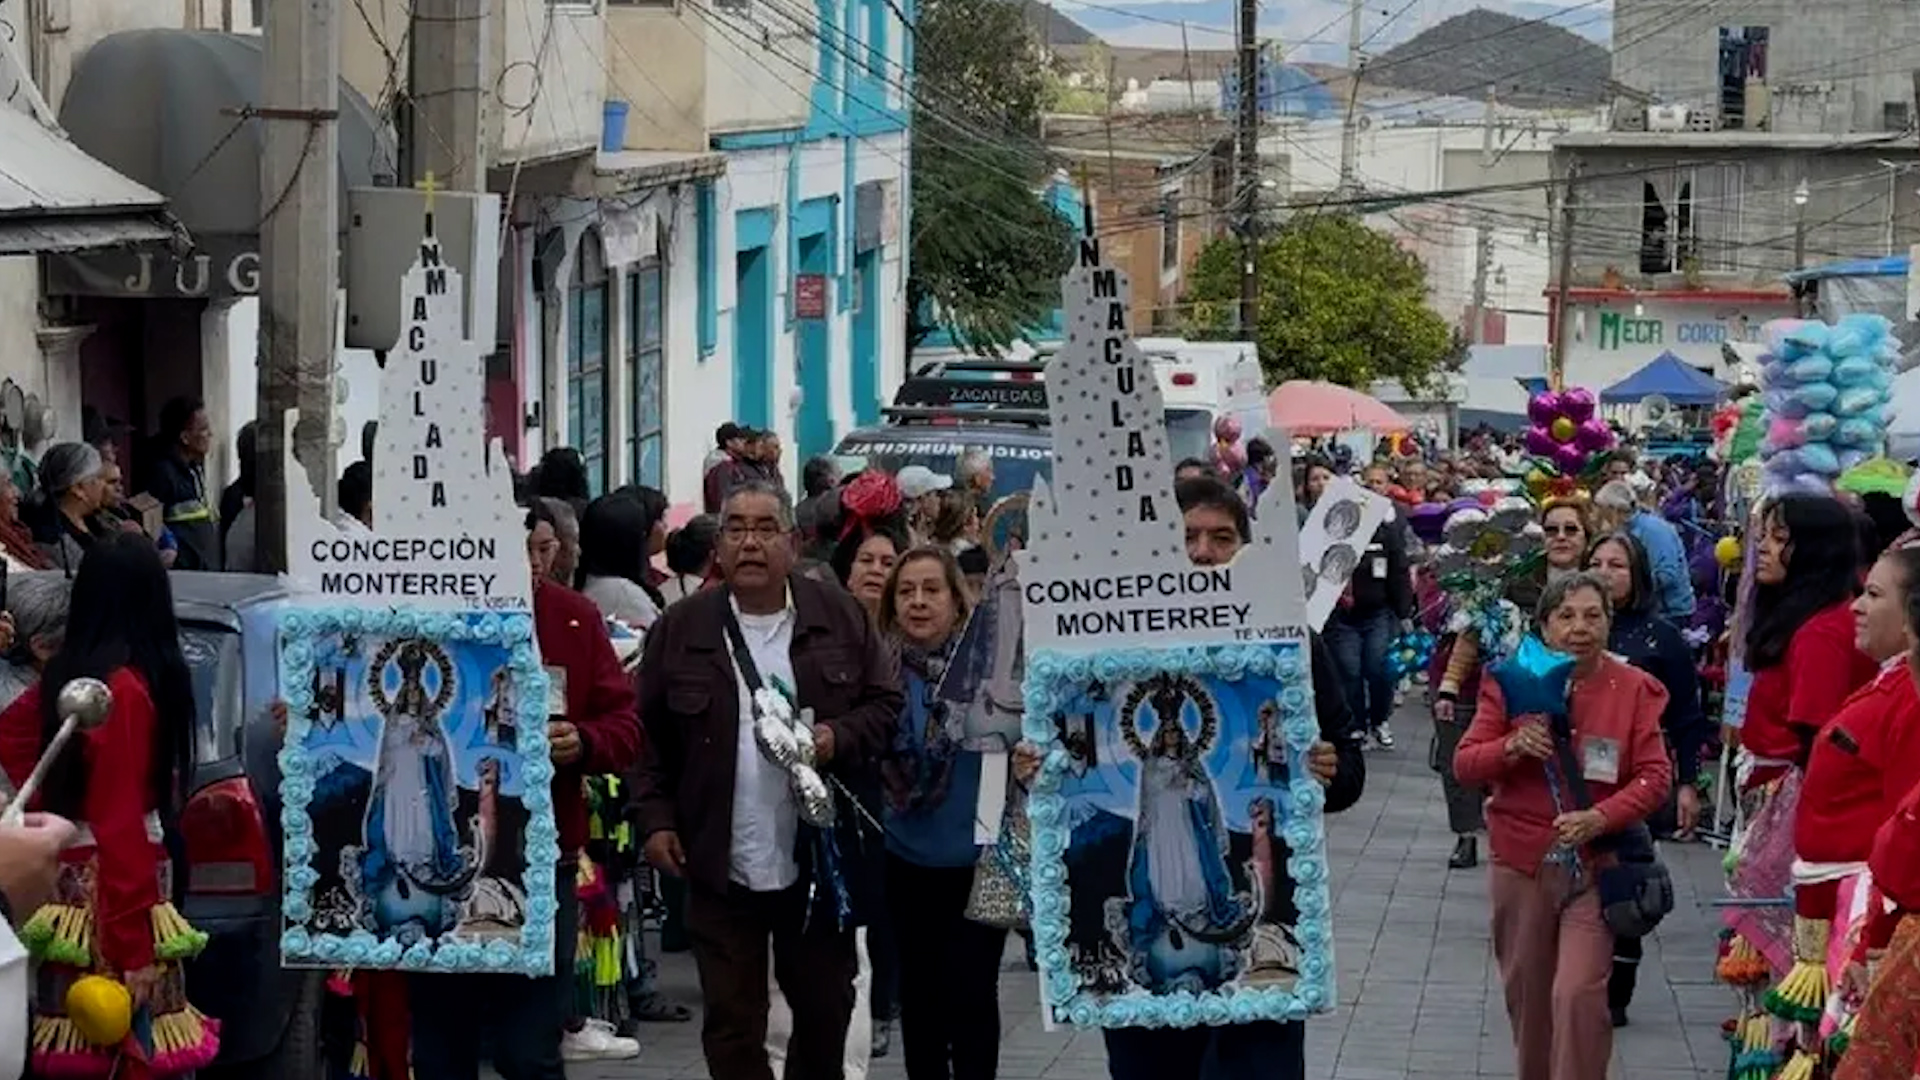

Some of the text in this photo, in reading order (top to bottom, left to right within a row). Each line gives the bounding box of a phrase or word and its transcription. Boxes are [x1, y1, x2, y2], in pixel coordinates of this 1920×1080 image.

[409, 212, 447, 508] INMACULADA
[1080, 205, 1158, 522] INMACULADA
[950, 387, 1043, 404] ZACATECAS
[321, 573, 497, 596] MONTERREY
[1026, 569, 1232, 604] CONCEPCION
[465, 597, 528, 609] TE VISITA
[1057, 604, 1251, 636] MONTERREY
[1235, 625, 1305, 641] TE VISITA
